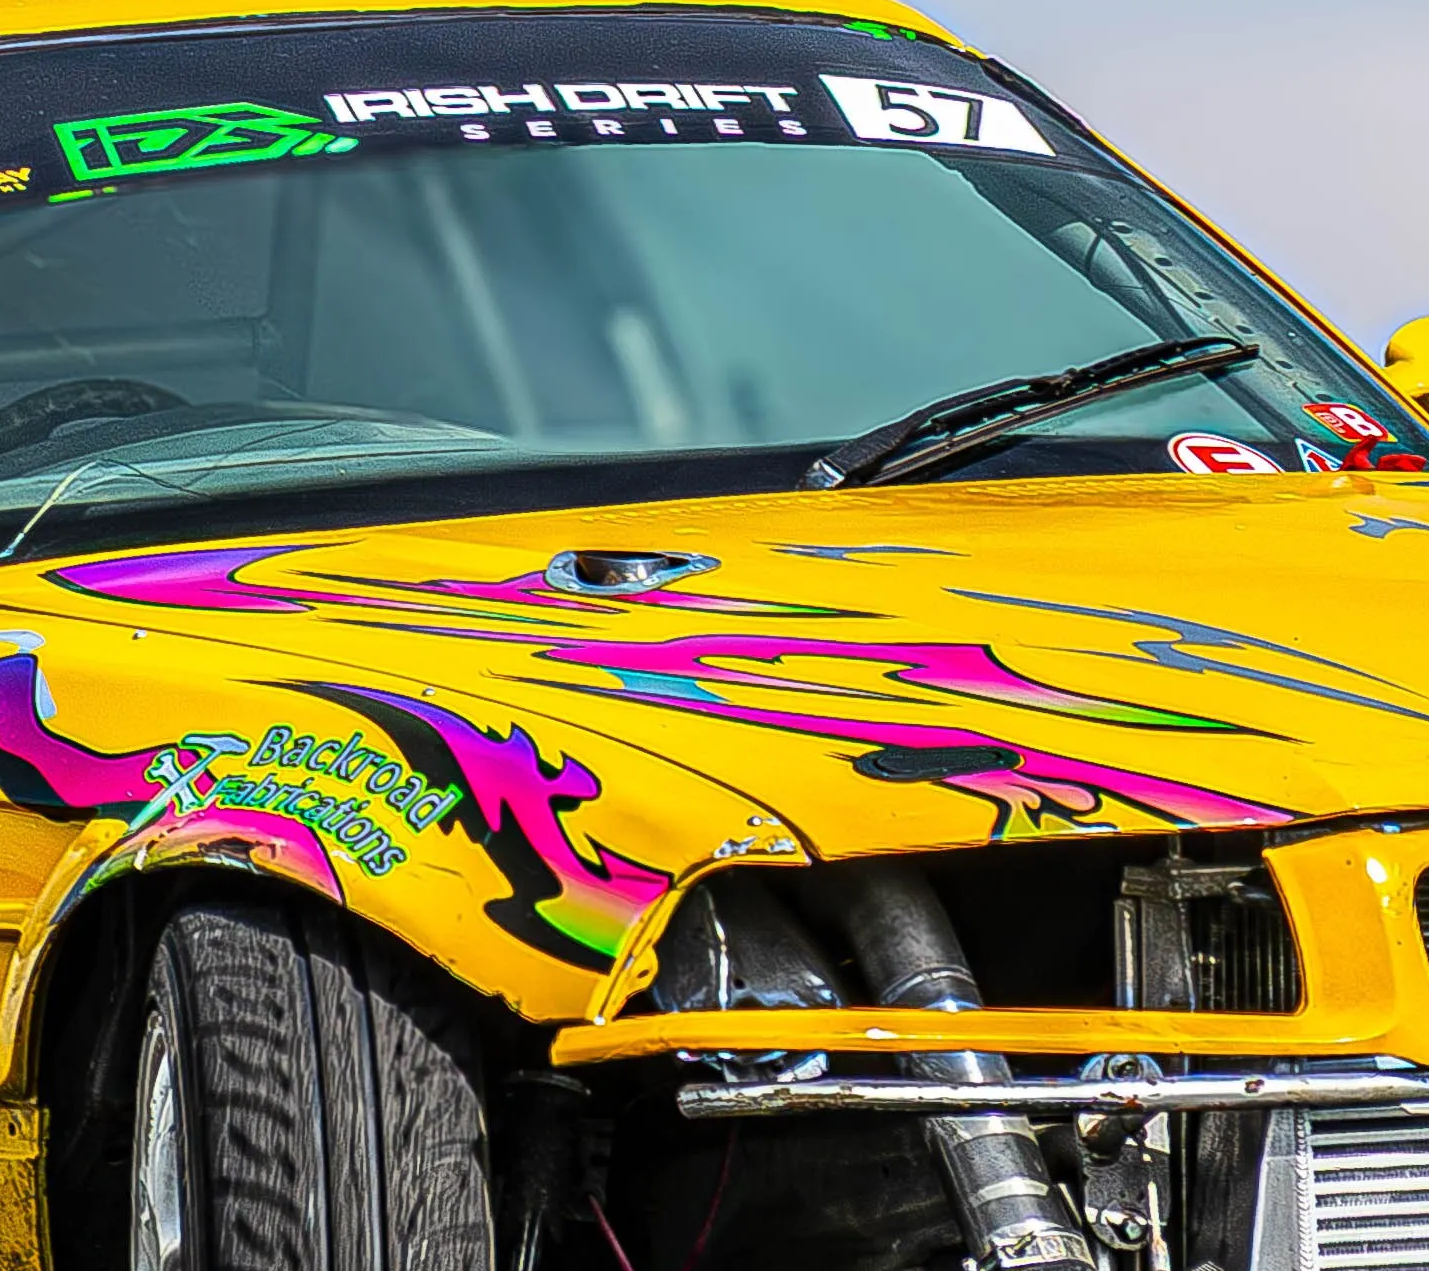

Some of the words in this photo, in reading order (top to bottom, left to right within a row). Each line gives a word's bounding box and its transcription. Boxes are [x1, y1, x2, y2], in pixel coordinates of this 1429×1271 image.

[323, 84, 553, 124] IRISH
[554, 81, 800, 114] DRIFT
[460, 117, 809, 141] SERIES
[874, 82, 985, 142] 57
[251, 725, 460, 832] Backroad
[211, 773, 406, 876] Fabrications
